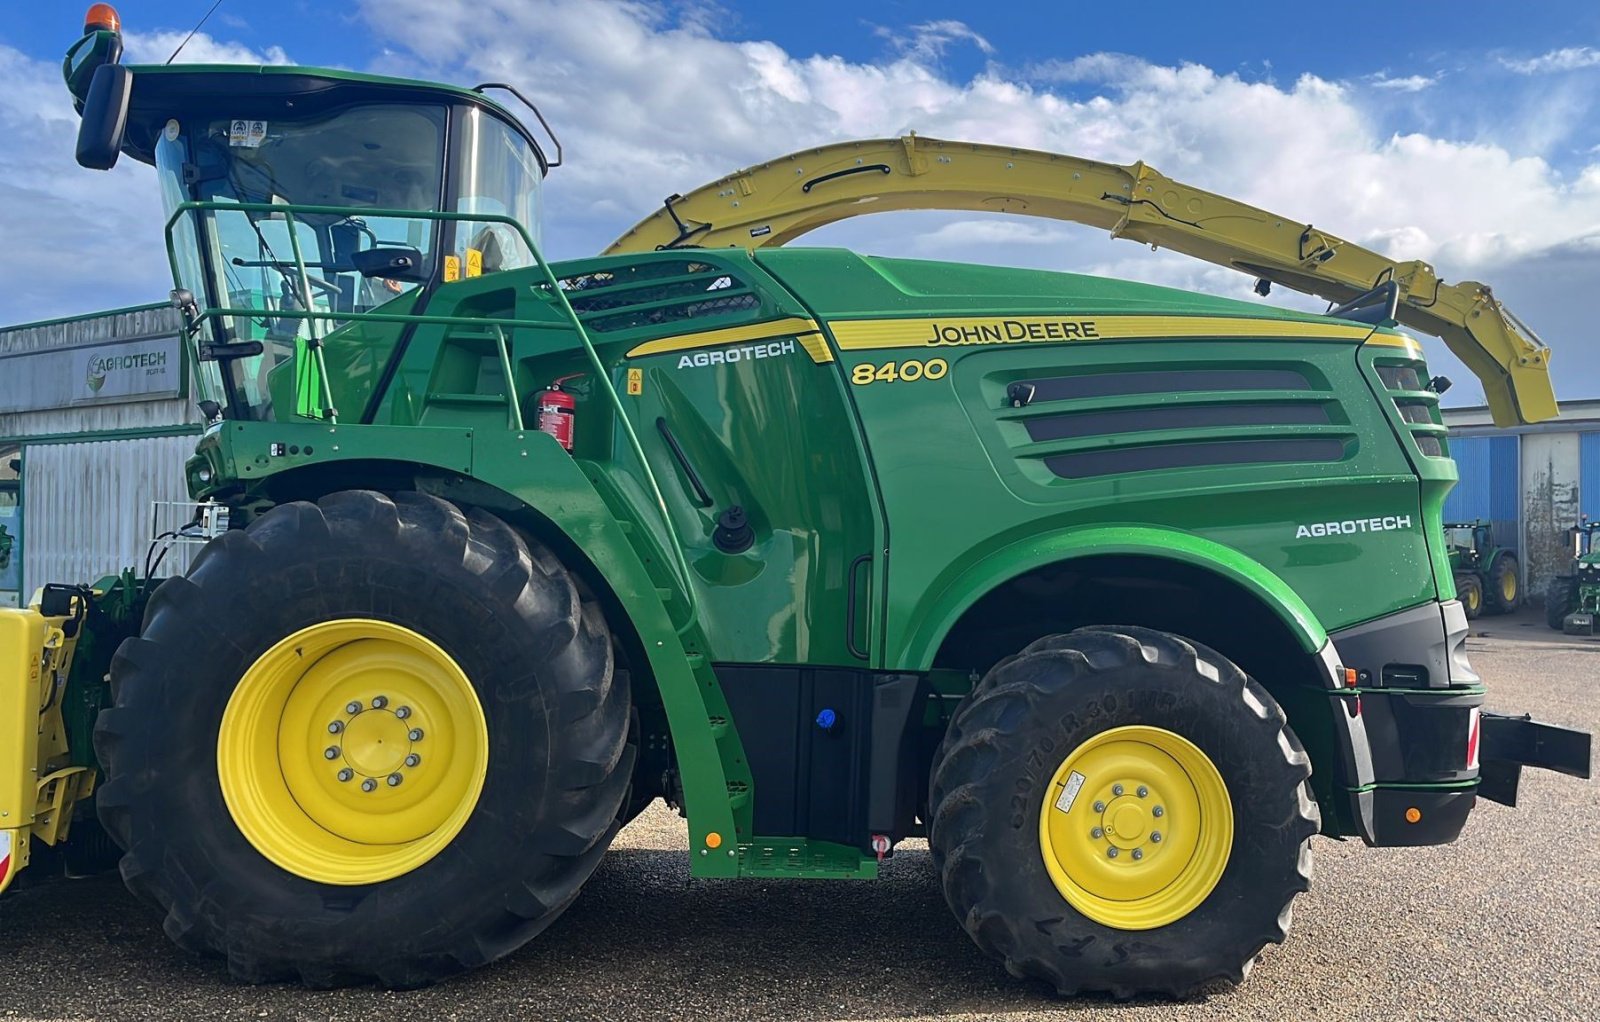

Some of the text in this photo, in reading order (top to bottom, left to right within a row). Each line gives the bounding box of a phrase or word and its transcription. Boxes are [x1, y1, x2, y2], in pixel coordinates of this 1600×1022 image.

[927, 320, 1099, 344] JOHN DEERE
[97, 351, 166, 372] AGROTECH
[677, 340, 795, 369] AGROTECH
[851, 358, 948, 385] 8400
[1295, 515, 1411, 539] AGROTECH
